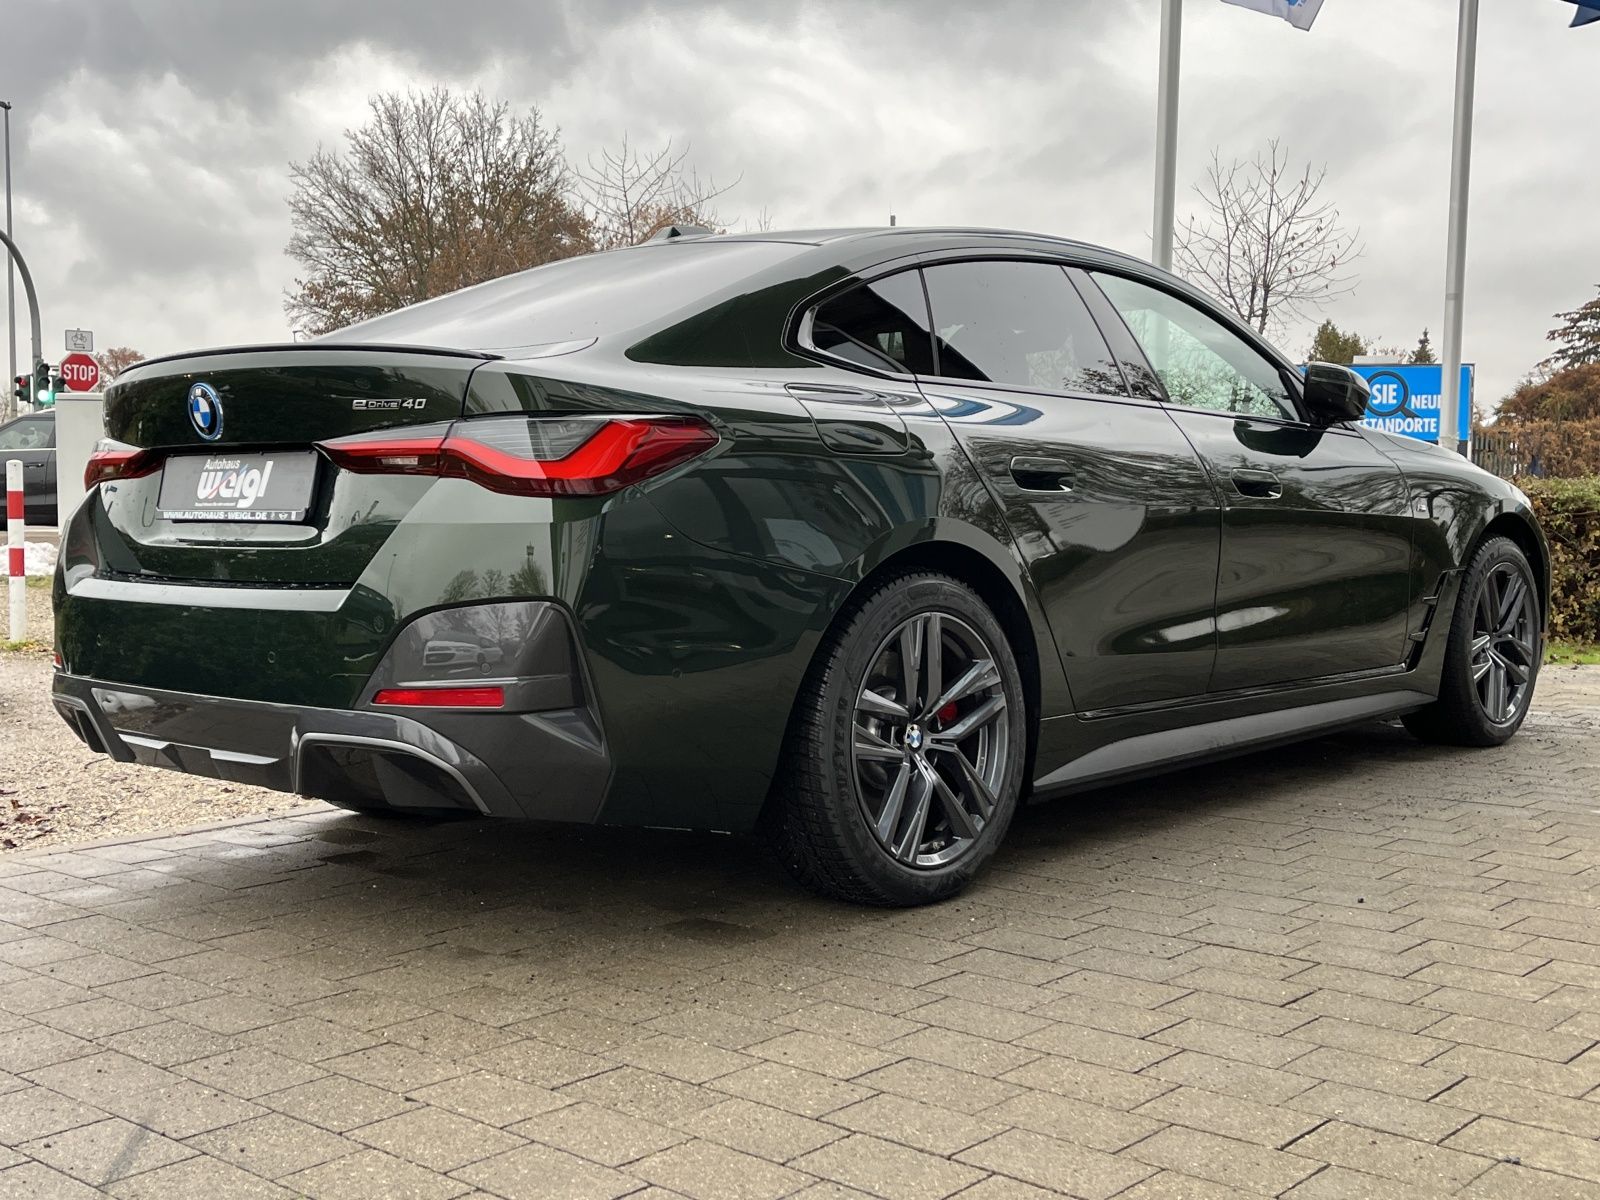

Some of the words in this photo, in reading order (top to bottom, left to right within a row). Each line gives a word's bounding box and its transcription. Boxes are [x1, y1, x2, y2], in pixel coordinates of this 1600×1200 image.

[63, 364, 96, 381] STOP
[1372, 384, 1398, 404] SIE
[402, 398, 427, 409] 40
[204, 459, 240, 470] Autohaus
